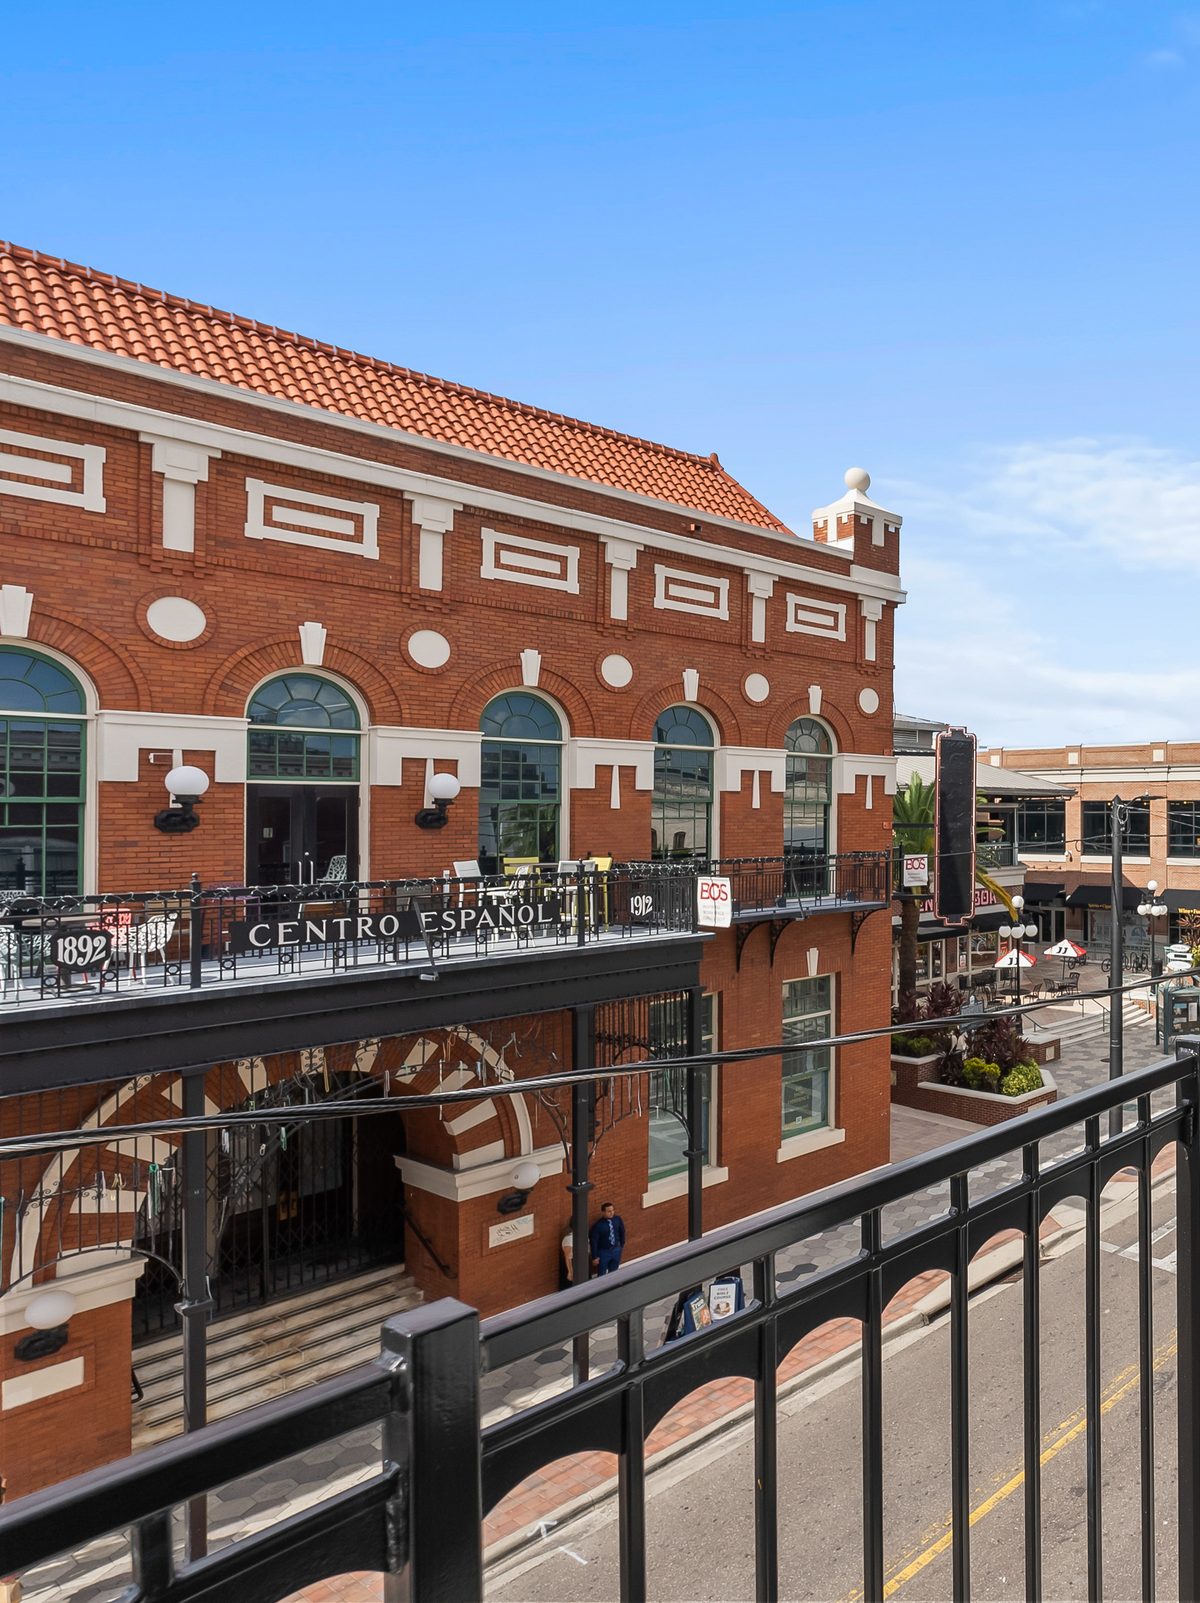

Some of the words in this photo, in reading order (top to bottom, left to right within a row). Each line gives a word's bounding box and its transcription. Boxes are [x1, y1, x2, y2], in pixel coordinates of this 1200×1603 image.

[630, 895, 653, 916] 1912
[248, 914, 400, 947] CENTRO
[420, 903, 553, 933] ESPAÑOL
[57, 935, 107, 966] 1892
[1056, 946, 1068, 954] JJ
